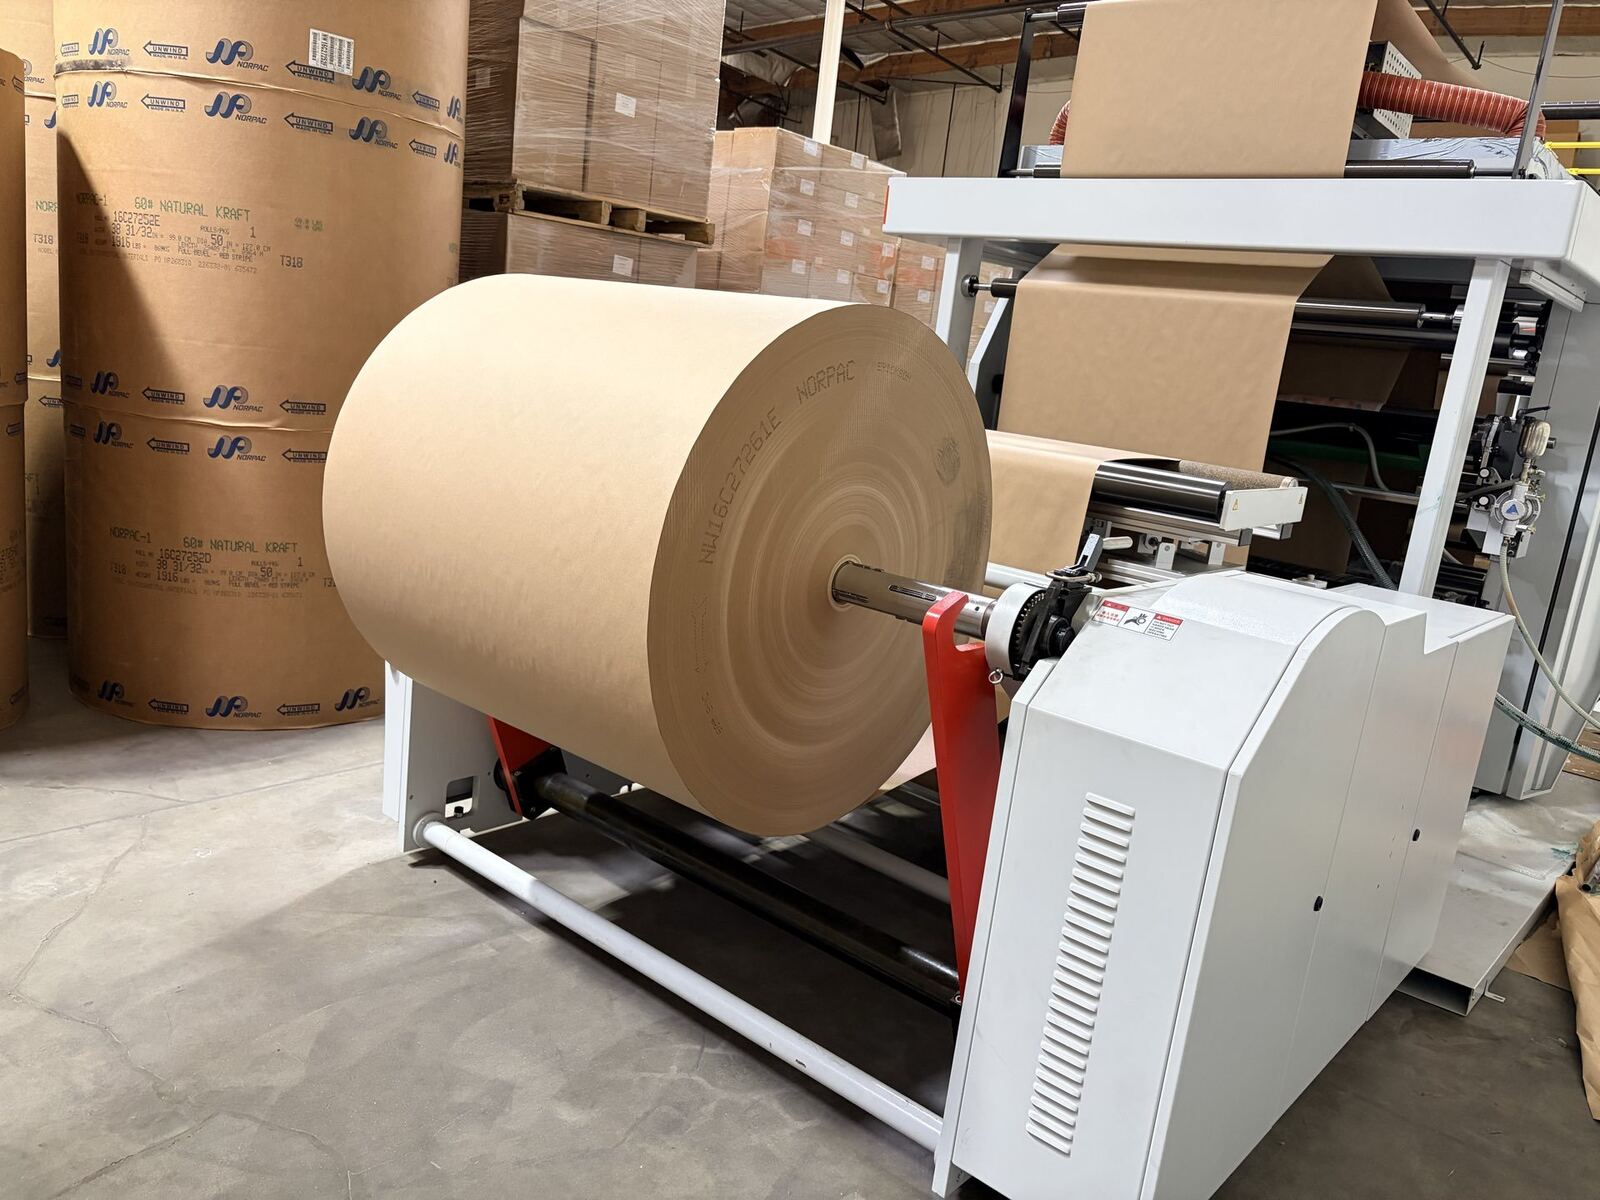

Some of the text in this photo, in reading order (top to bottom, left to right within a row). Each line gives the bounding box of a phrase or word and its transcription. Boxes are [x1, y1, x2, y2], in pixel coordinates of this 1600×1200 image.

[107, 48, 130, 56] NORPAC
[153, 46, 183, 54] UNWIND
[237, 61, 269, 72] NORPAC
[297, 66, 329, 78] UNWIND
[378, 89, 402, 100] NORPAC
[106, 101, 129, 109] NORPAC
[235, 114, 267, 124] NORPAC
[296, 118, 328, 128] UNWIND
[374, 140, 398, 150] NORPAC
[134, 196, 250, 222] 60# NATURAL KRAFT
[113, 211, 160, 227] 16C27252E
[125, 224, 152, 238] 31/32
[250, 226, 256, 238] 1
[33, 233, 54, 244] T318
[112, 236, 130, 248] 1916
[211, 234, 224, 246] 50
[280, 254, 304, 268] T318
[796, 360, 856, 405] NORPAC
[232, 404, 264, 412] NORPAC
[236, 454, 266, 462] NORPAC
[700, 407, 782, 565] NW16C27261E
[110, 527, 152, 544] NORPAC-1
[183, 536, 298, 554] 60# NATURAL KRAFT
[159, 548, 212, 564] 16C27252D
[298, 557, 304, 567] 1
[156, 559, 168, 571] 38
[173, 561, 202, 574] 31/32
[260, 567, 273, 578] 50
[156, 570, 178, 582] 1916
